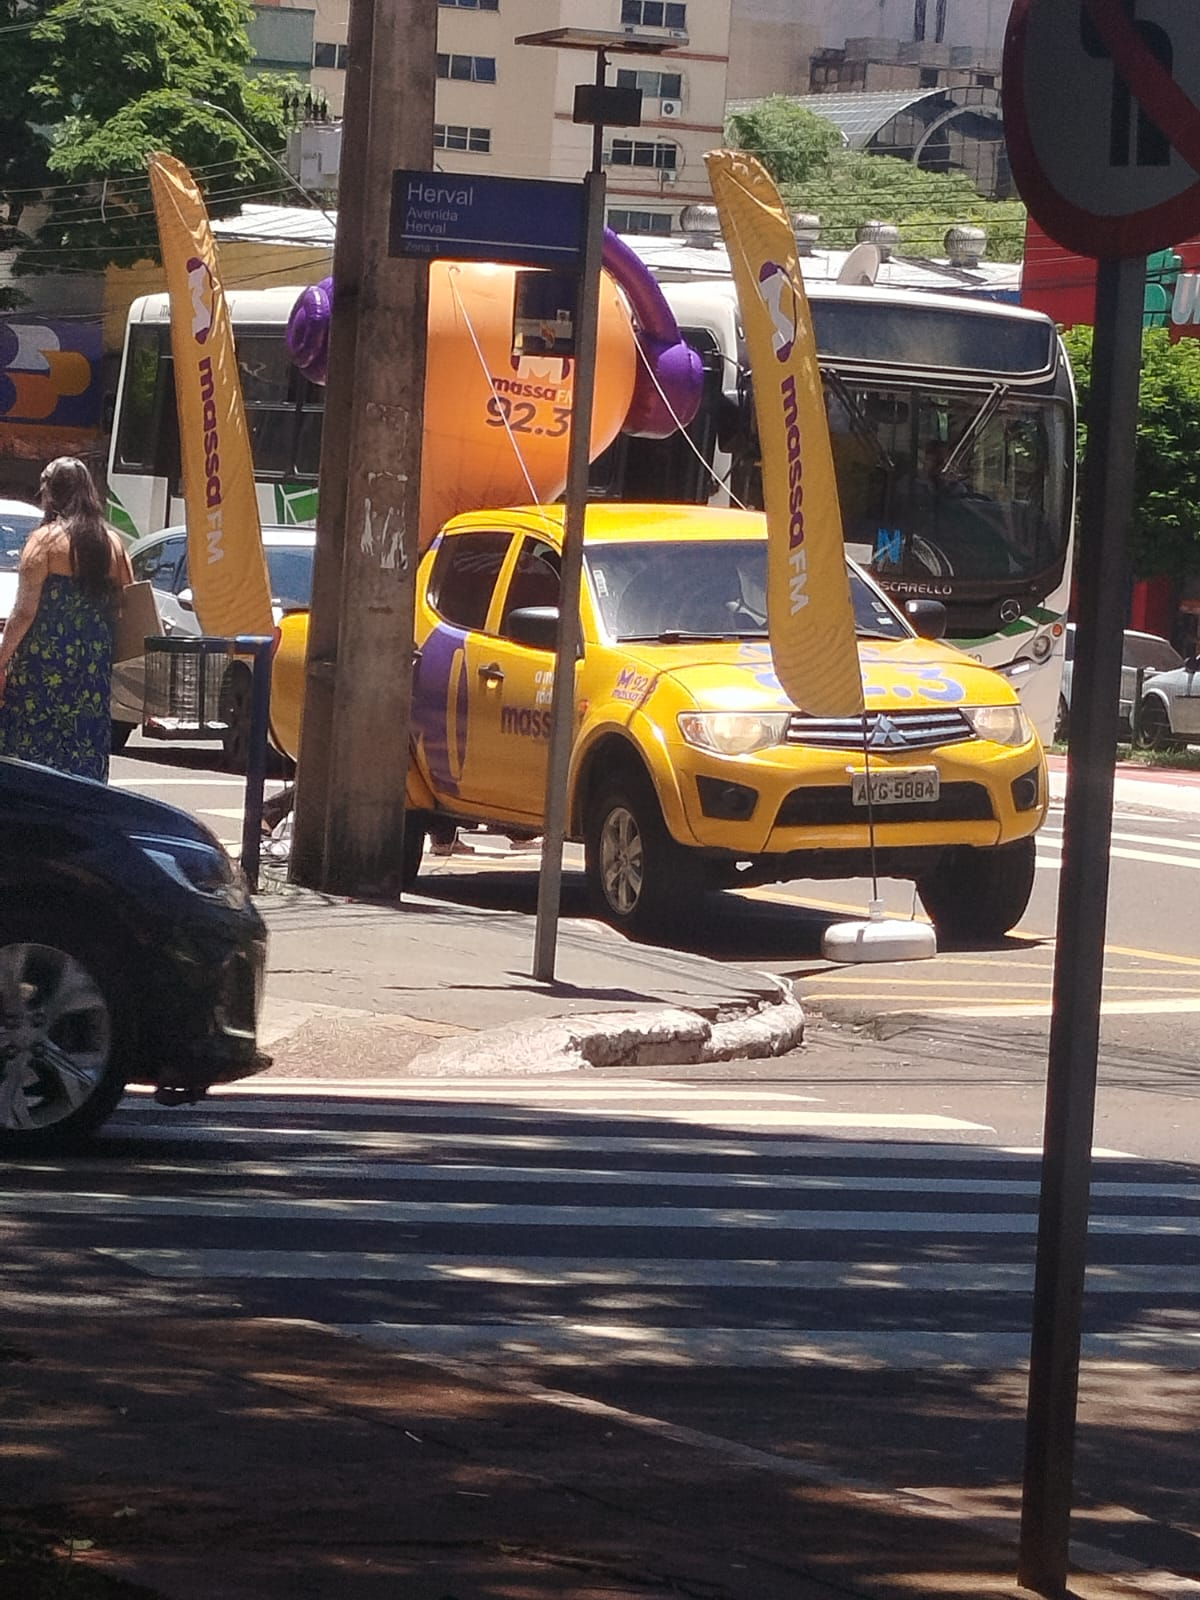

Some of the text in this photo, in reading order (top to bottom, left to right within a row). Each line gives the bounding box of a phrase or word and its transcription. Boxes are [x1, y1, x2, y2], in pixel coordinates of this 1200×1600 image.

[407, 182, 474, 206] Herval
[407, 206, 459, 222] Avenida
[405, 219, 447, 234] Herval
[486, 396, 572, 438] 92.3
[501, 704, 553, 739] mass
